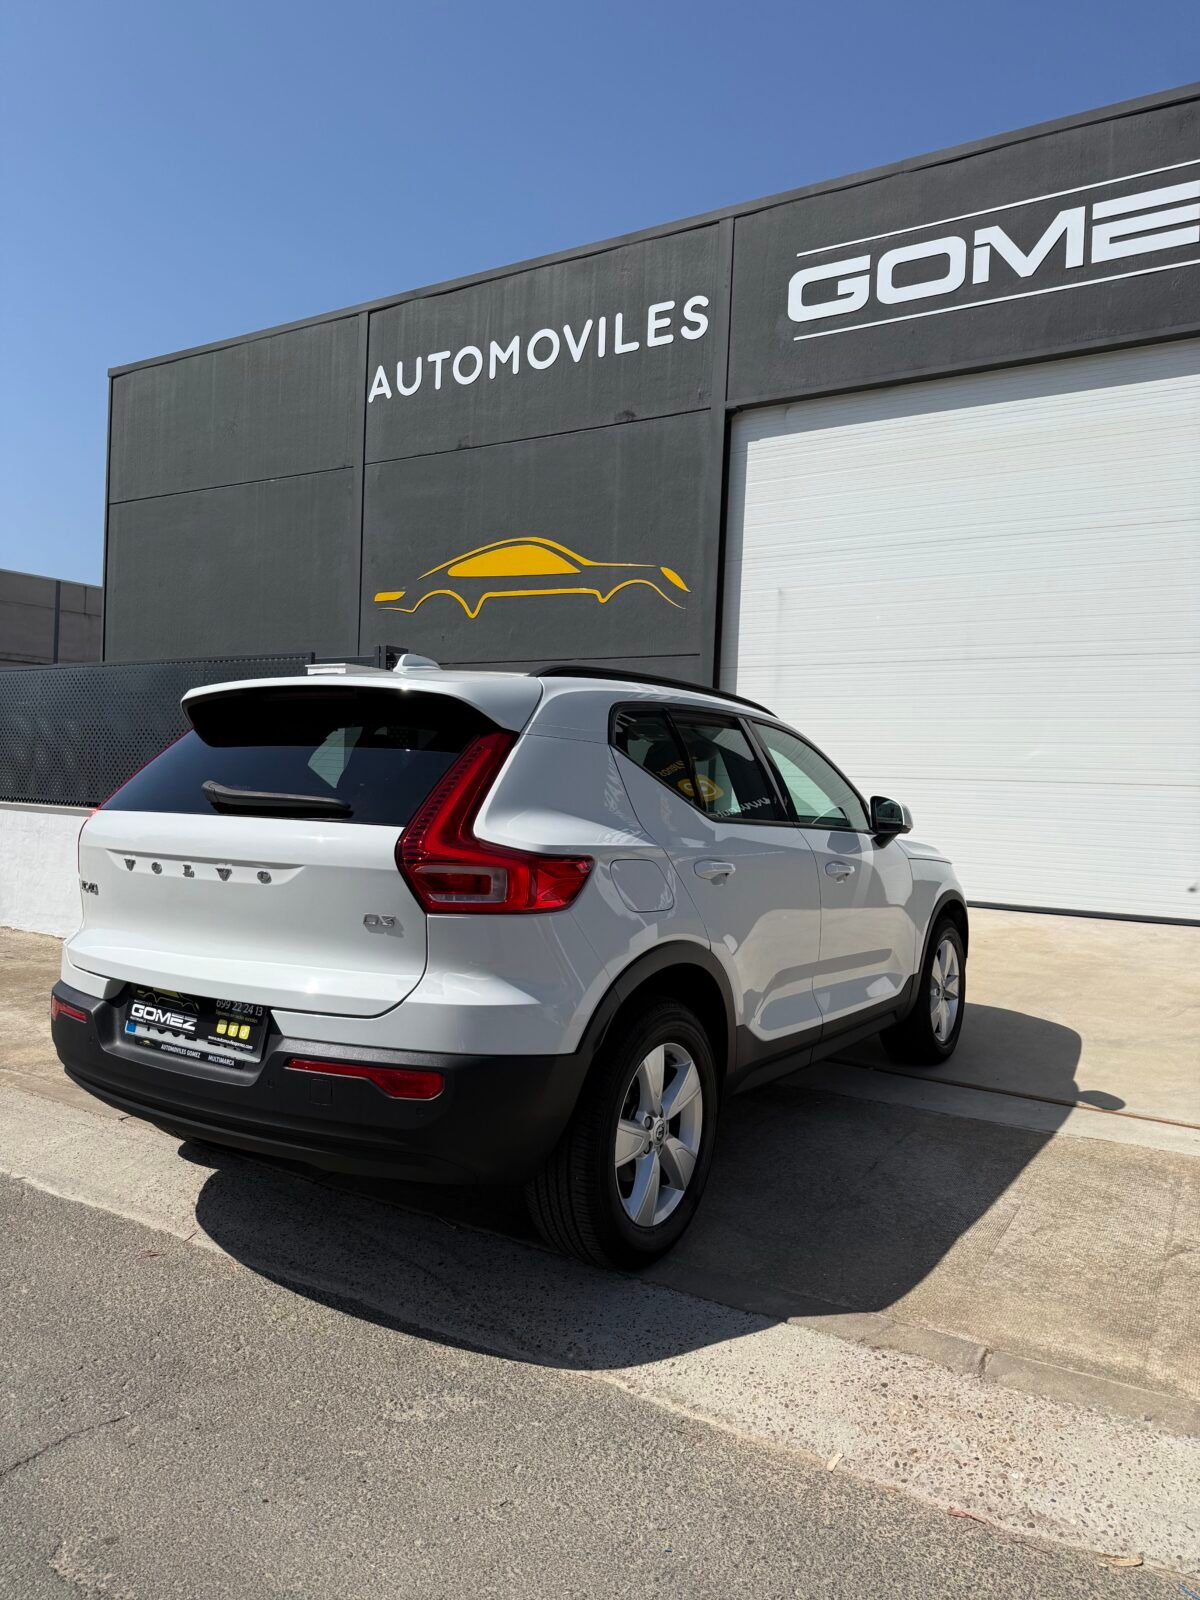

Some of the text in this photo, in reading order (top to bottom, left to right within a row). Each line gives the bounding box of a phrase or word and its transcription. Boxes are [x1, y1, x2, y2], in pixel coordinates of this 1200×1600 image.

[367, 295, 709, 403] AUTOMOVILES
[124, 856, 272, 884] VOLVO
[363, 912, 396, 924] D3
[232, 1002, 243, 1012] 22
[243, 1004, 254, 1015] 24
[131, 1003, 197, 1031] GOMEZ
[160, 1043, 201, 1059] AUTOMOVILES GOMEZ
[207, 1054, 235, 1067] MULTIMARCA
